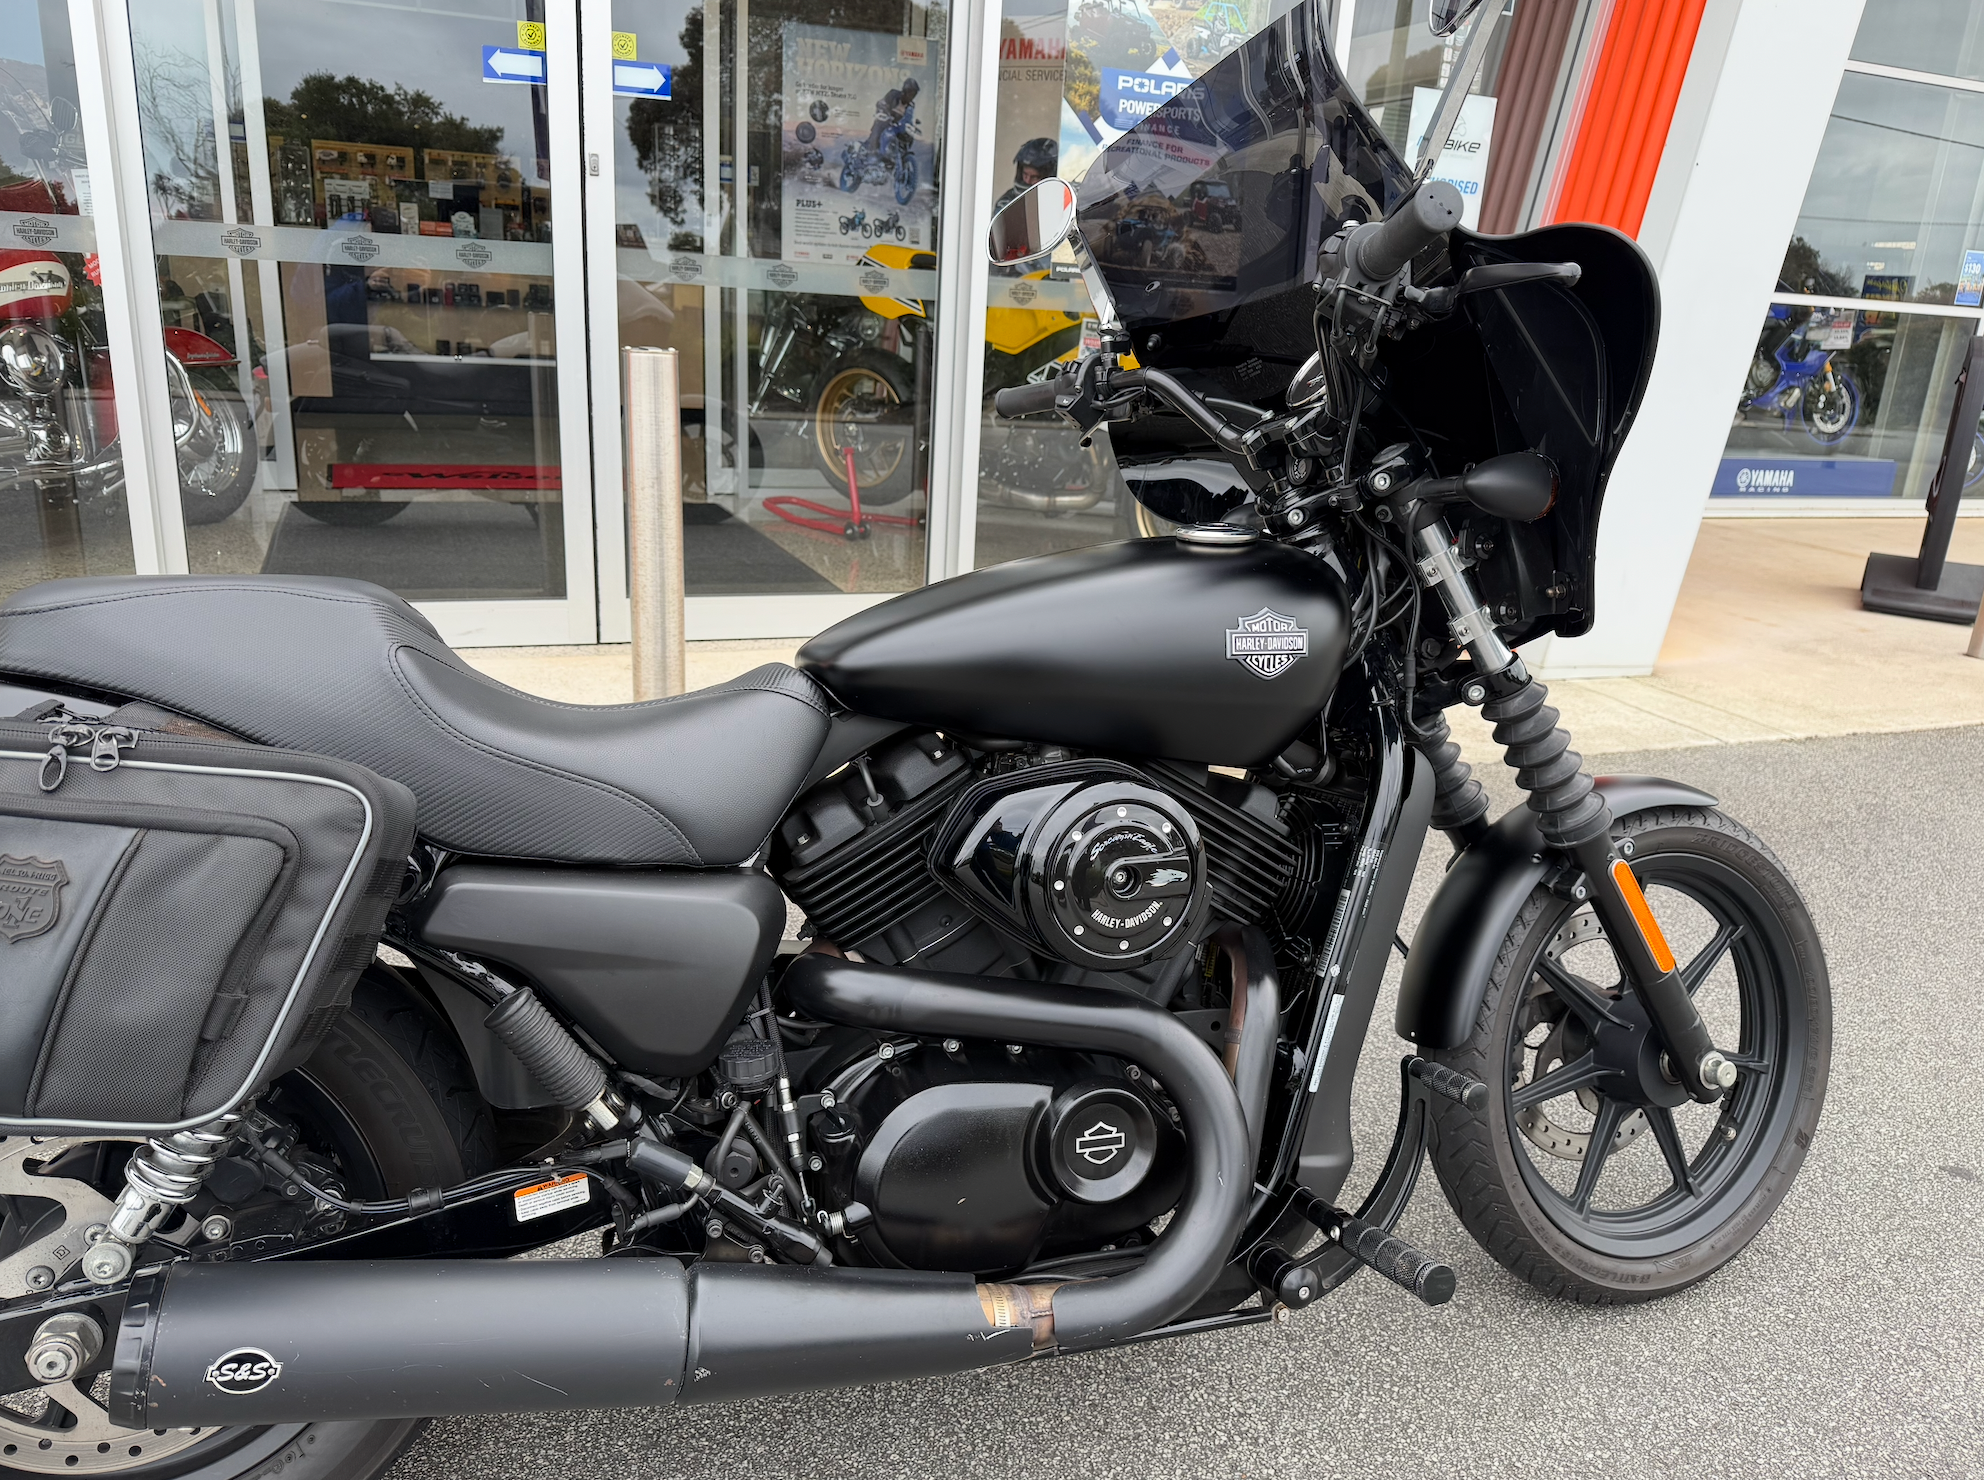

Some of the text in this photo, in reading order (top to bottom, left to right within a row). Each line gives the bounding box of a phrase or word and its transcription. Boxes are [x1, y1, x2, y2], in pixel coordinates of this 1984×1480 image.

[796, 36, 851, 61] NEW
[1025, 69, 1067, 82] SERVICE
[1117, 74, 1205, 100] POLARIS
[1118, 98, 1200, 121] POWERSPORTS
[1126, 138, 1184, 154] FINANCE FOR
[1164, 152, 1211, 166] PRODUCTS
[796, 198, 823, 209] PLUS+
[1964, 262, 1981, 275] $130
[1751, 469, 1795, 487] YAMAHA
[1251, 617, 1289, 632] MOTOR
[1235, 636, 1304, 651] HARLEY-DAVIDSON
[1251, 654, 1289, 673] CYCLES
[1691, 831, 1798, 910] BRIDGESTONE
[216, 1362, 271, 1382] S&S
